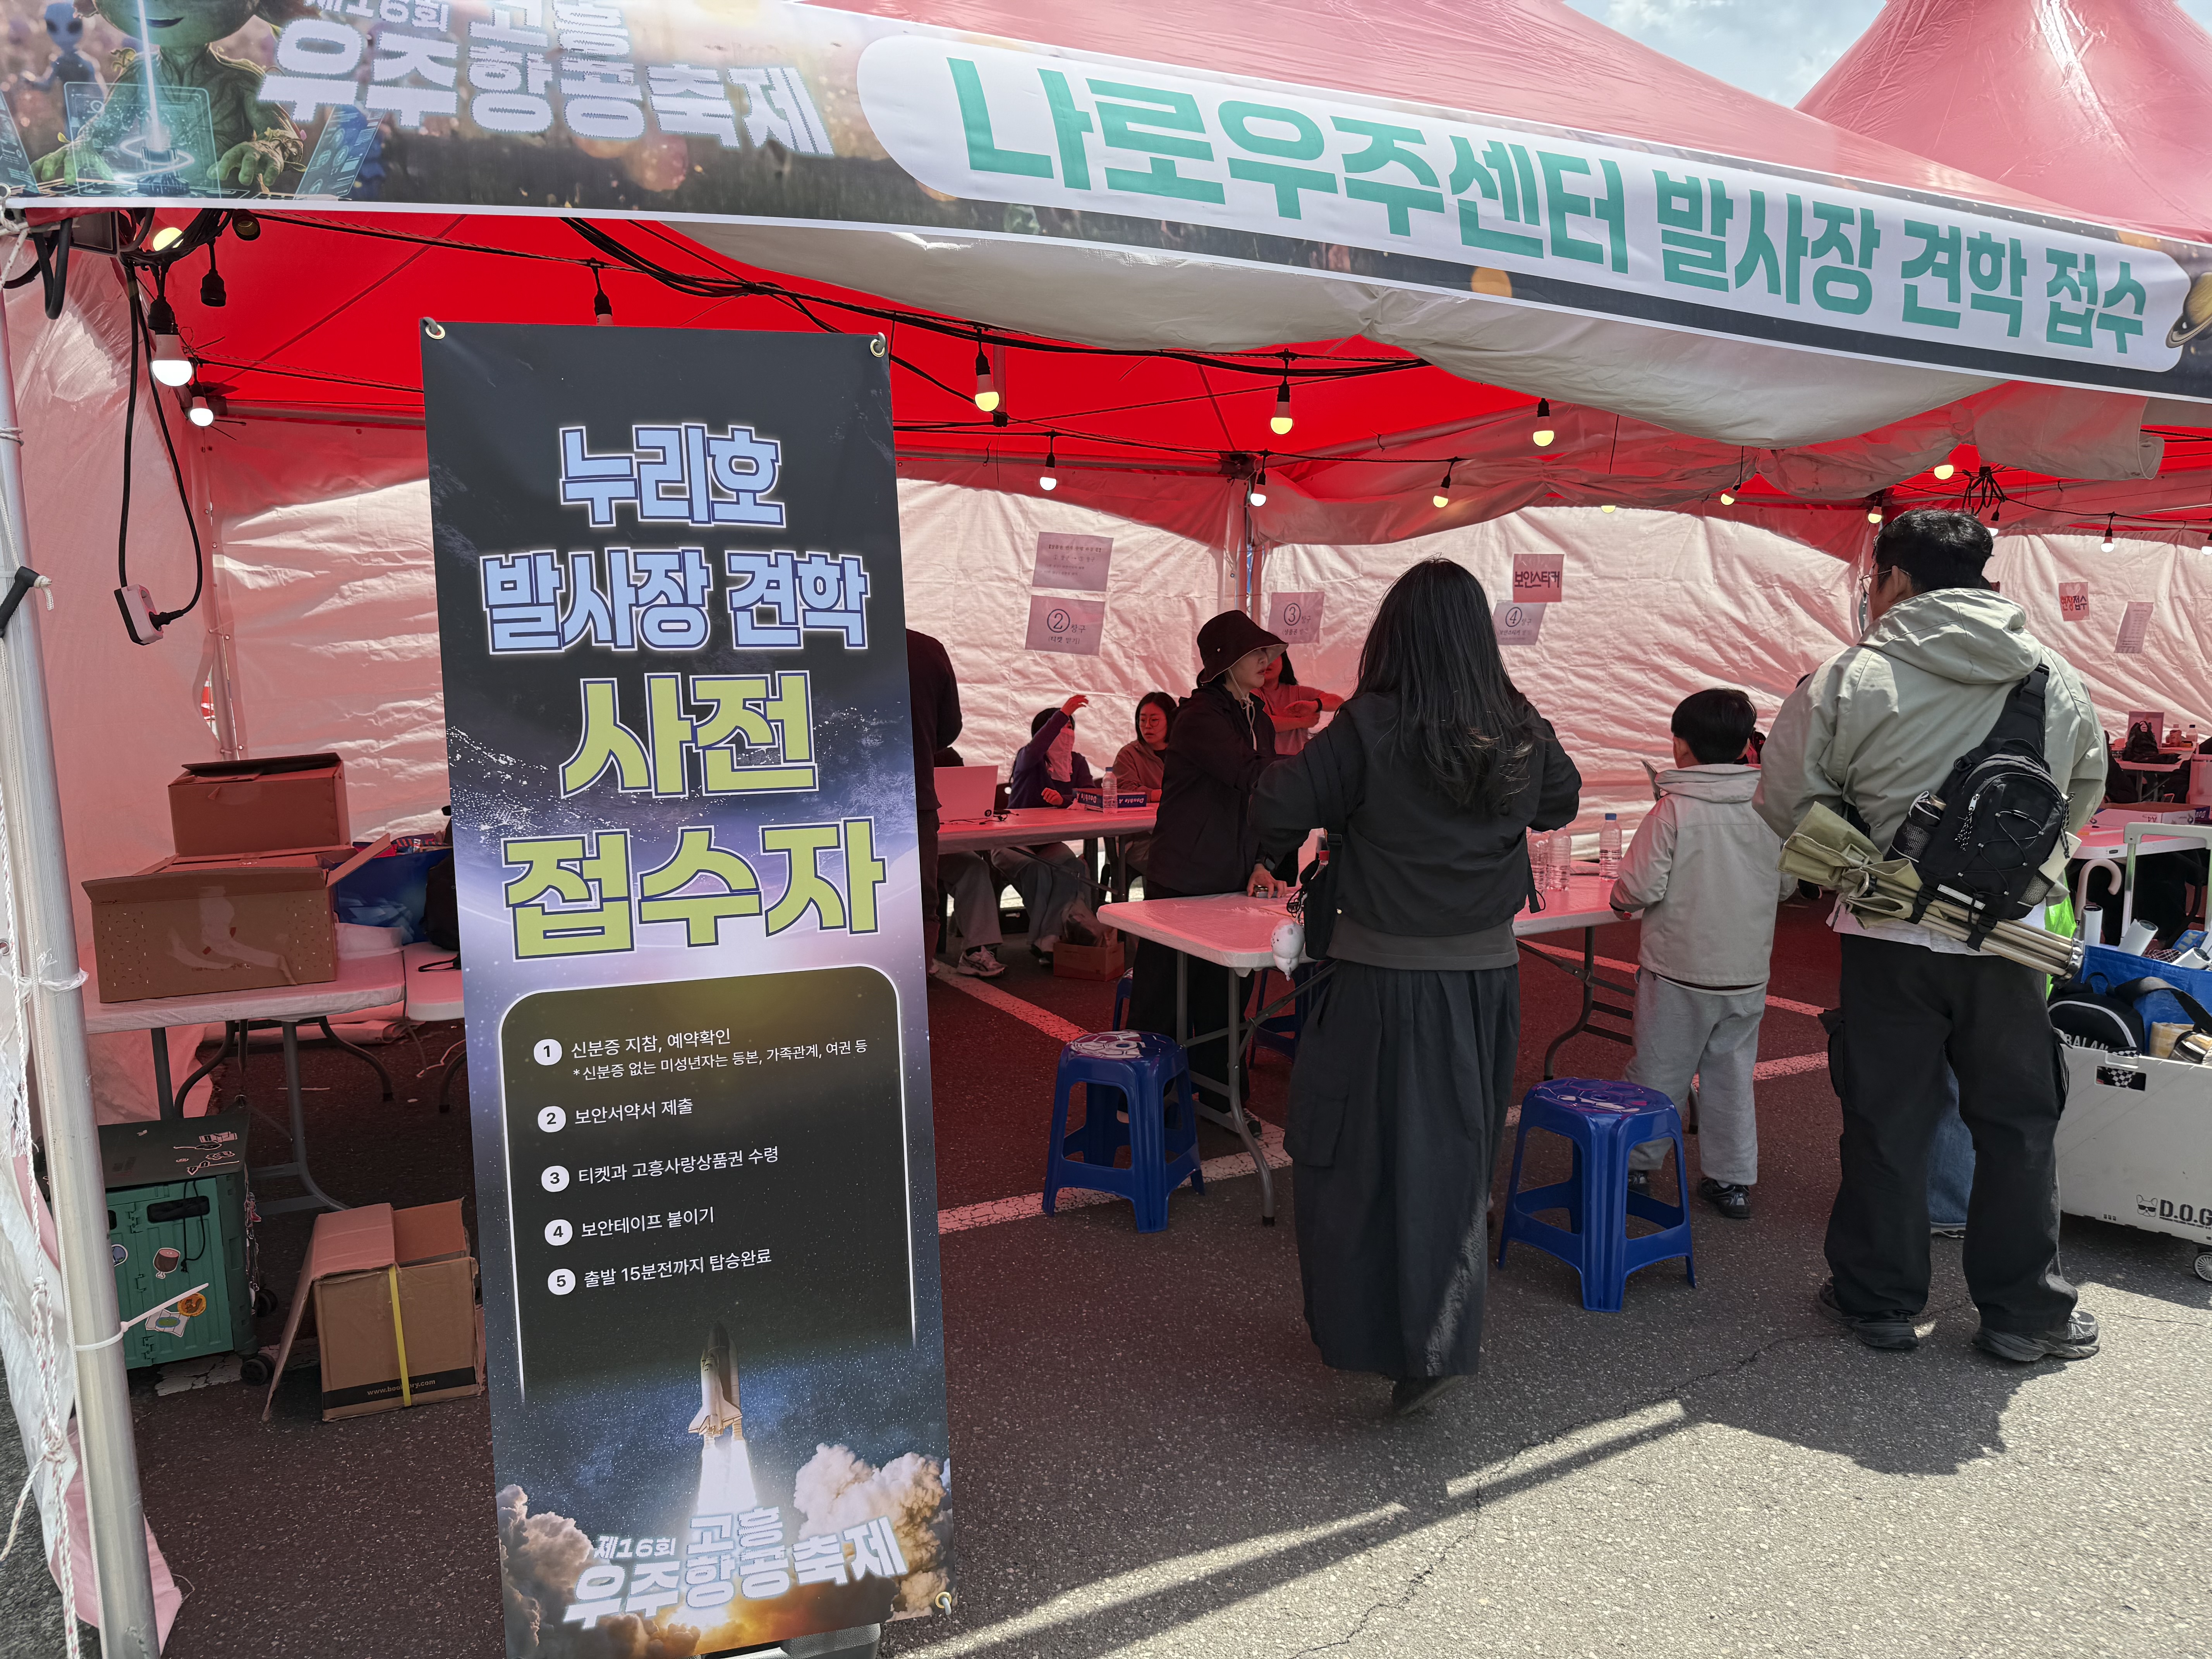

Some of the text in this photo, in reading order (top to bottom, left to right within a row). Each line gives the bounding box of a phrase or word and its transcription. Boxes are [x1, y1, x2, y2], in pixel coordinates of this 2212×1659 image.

[257, 18, 834, 156] 우주항공축제
[946, 57, 2146, 354] 나로우주센터 발사장 견학 접수
[559, 422, 787, 528] 누리호
[479, 546, 871, 655] 발사장 견학
[1514, 571, 1560, 588] 보안스티커
[559, 670, 819, 799] 사전
[500, 816, 887, 962] 접수자
[571, 1039, 620, 1060] 신분증
[625, 1035, 663, 1054] 지참,
[667, 1028, 731, 1050] 예약확인
[629, 1061, 656, 1077] 없는
[661, 1056, 728, 1073] 미성년자는
[732, 1051, 763, 1065] 등본,
[767, 1044, 822, 1062] 가족관계,
[826, 1041, 851, 1056] 여권
[855, 1039, 867, 1053] 등
[575, 1101, 656, 1125] 보안서약서
[661, 1098, 694, 1115] 제출
[578, 1166, 627, 1185] 티켓과
[632, 1150, 744, 1178] 고흥사랑상품권
[748, 1146, 779, 1164] 수령
[581, 1215, 663, 1238] 보안테이프
[667, 1206, 714, 1228] 붙이기
[584, 1269, 617, 1288] 출발
[621, 1256, 705, 1282] 15분전까지
[709, 1249, 772, 1271] 탑승완료
[593, 1506, 784, 1559] 제16회 고흥
[563, 1516, 909, 1630] 우주항공축제
